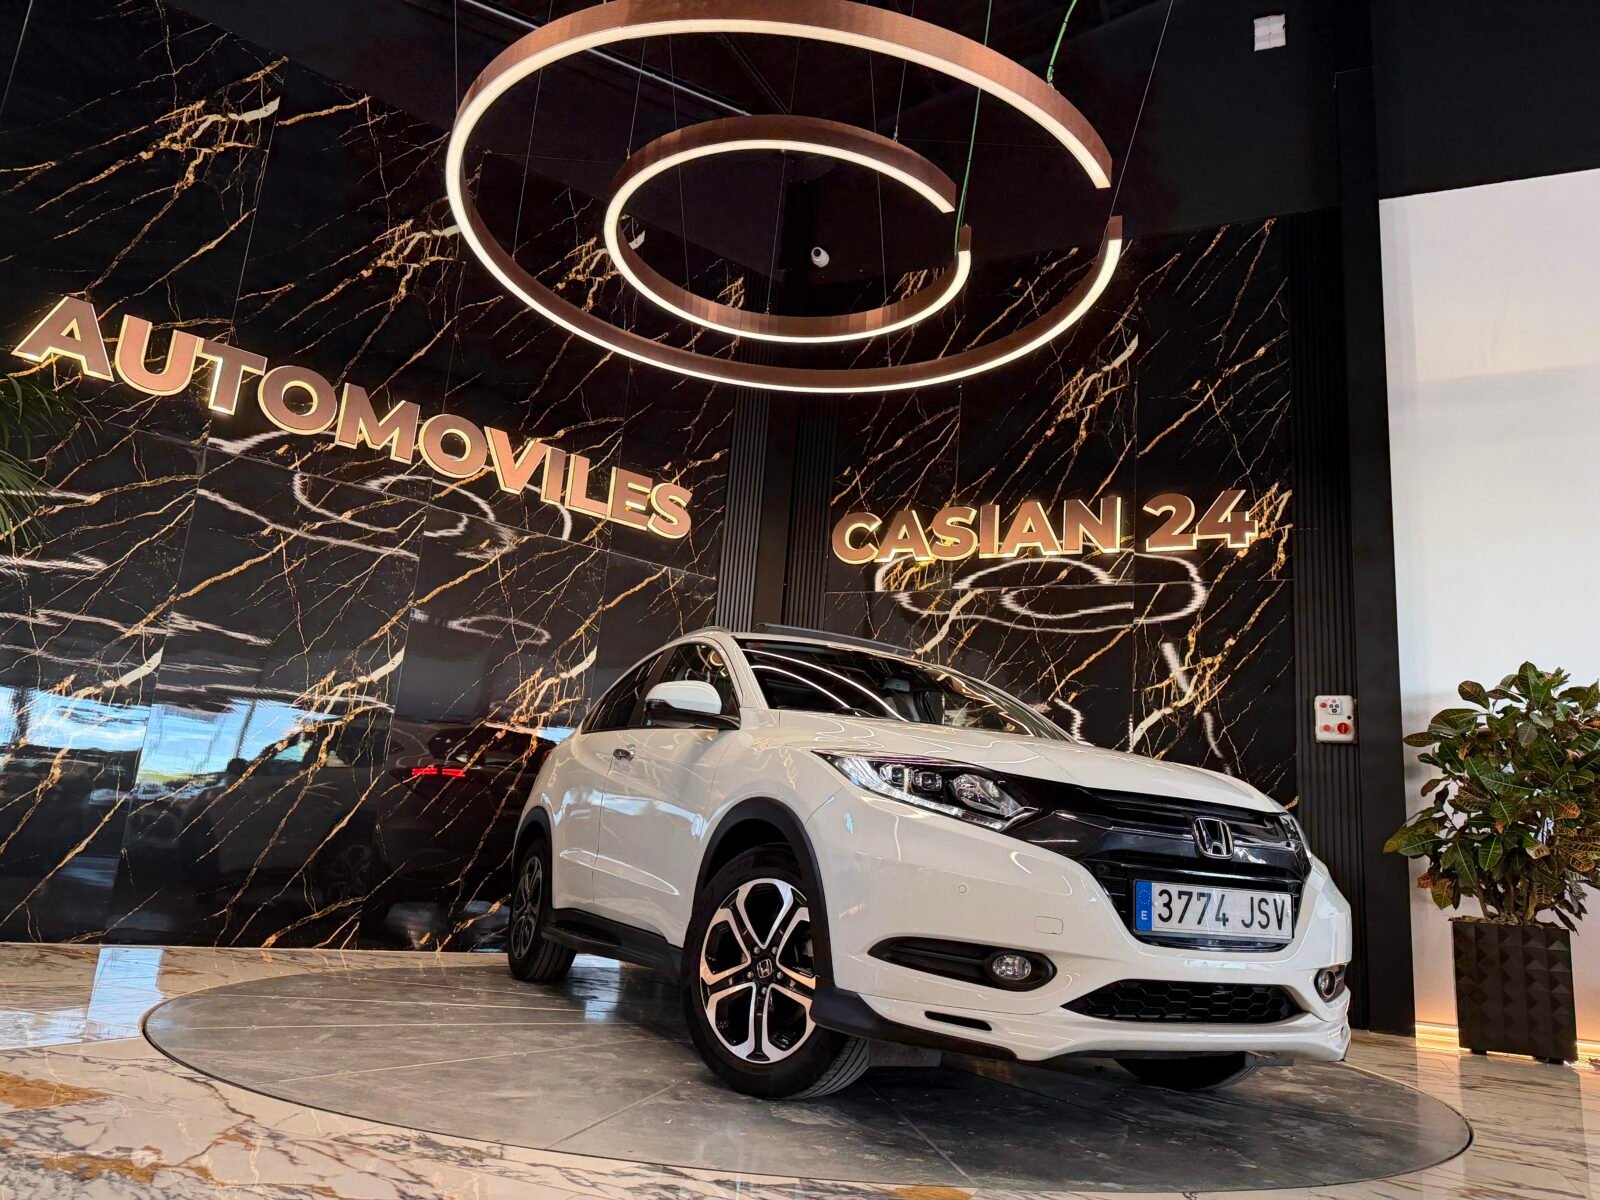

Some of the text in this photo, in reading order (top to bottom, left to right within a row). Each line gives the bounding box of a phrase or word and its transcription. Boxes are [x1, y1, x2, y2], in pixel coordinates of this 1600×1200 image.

[11, 296, 693, 540] AUTOMOVILES
[831, 489, 1259, 564] CASIAN 24
[1140, 910, 1148, 921] E
[1158, 889, 1285, 930] 3774 JSV
